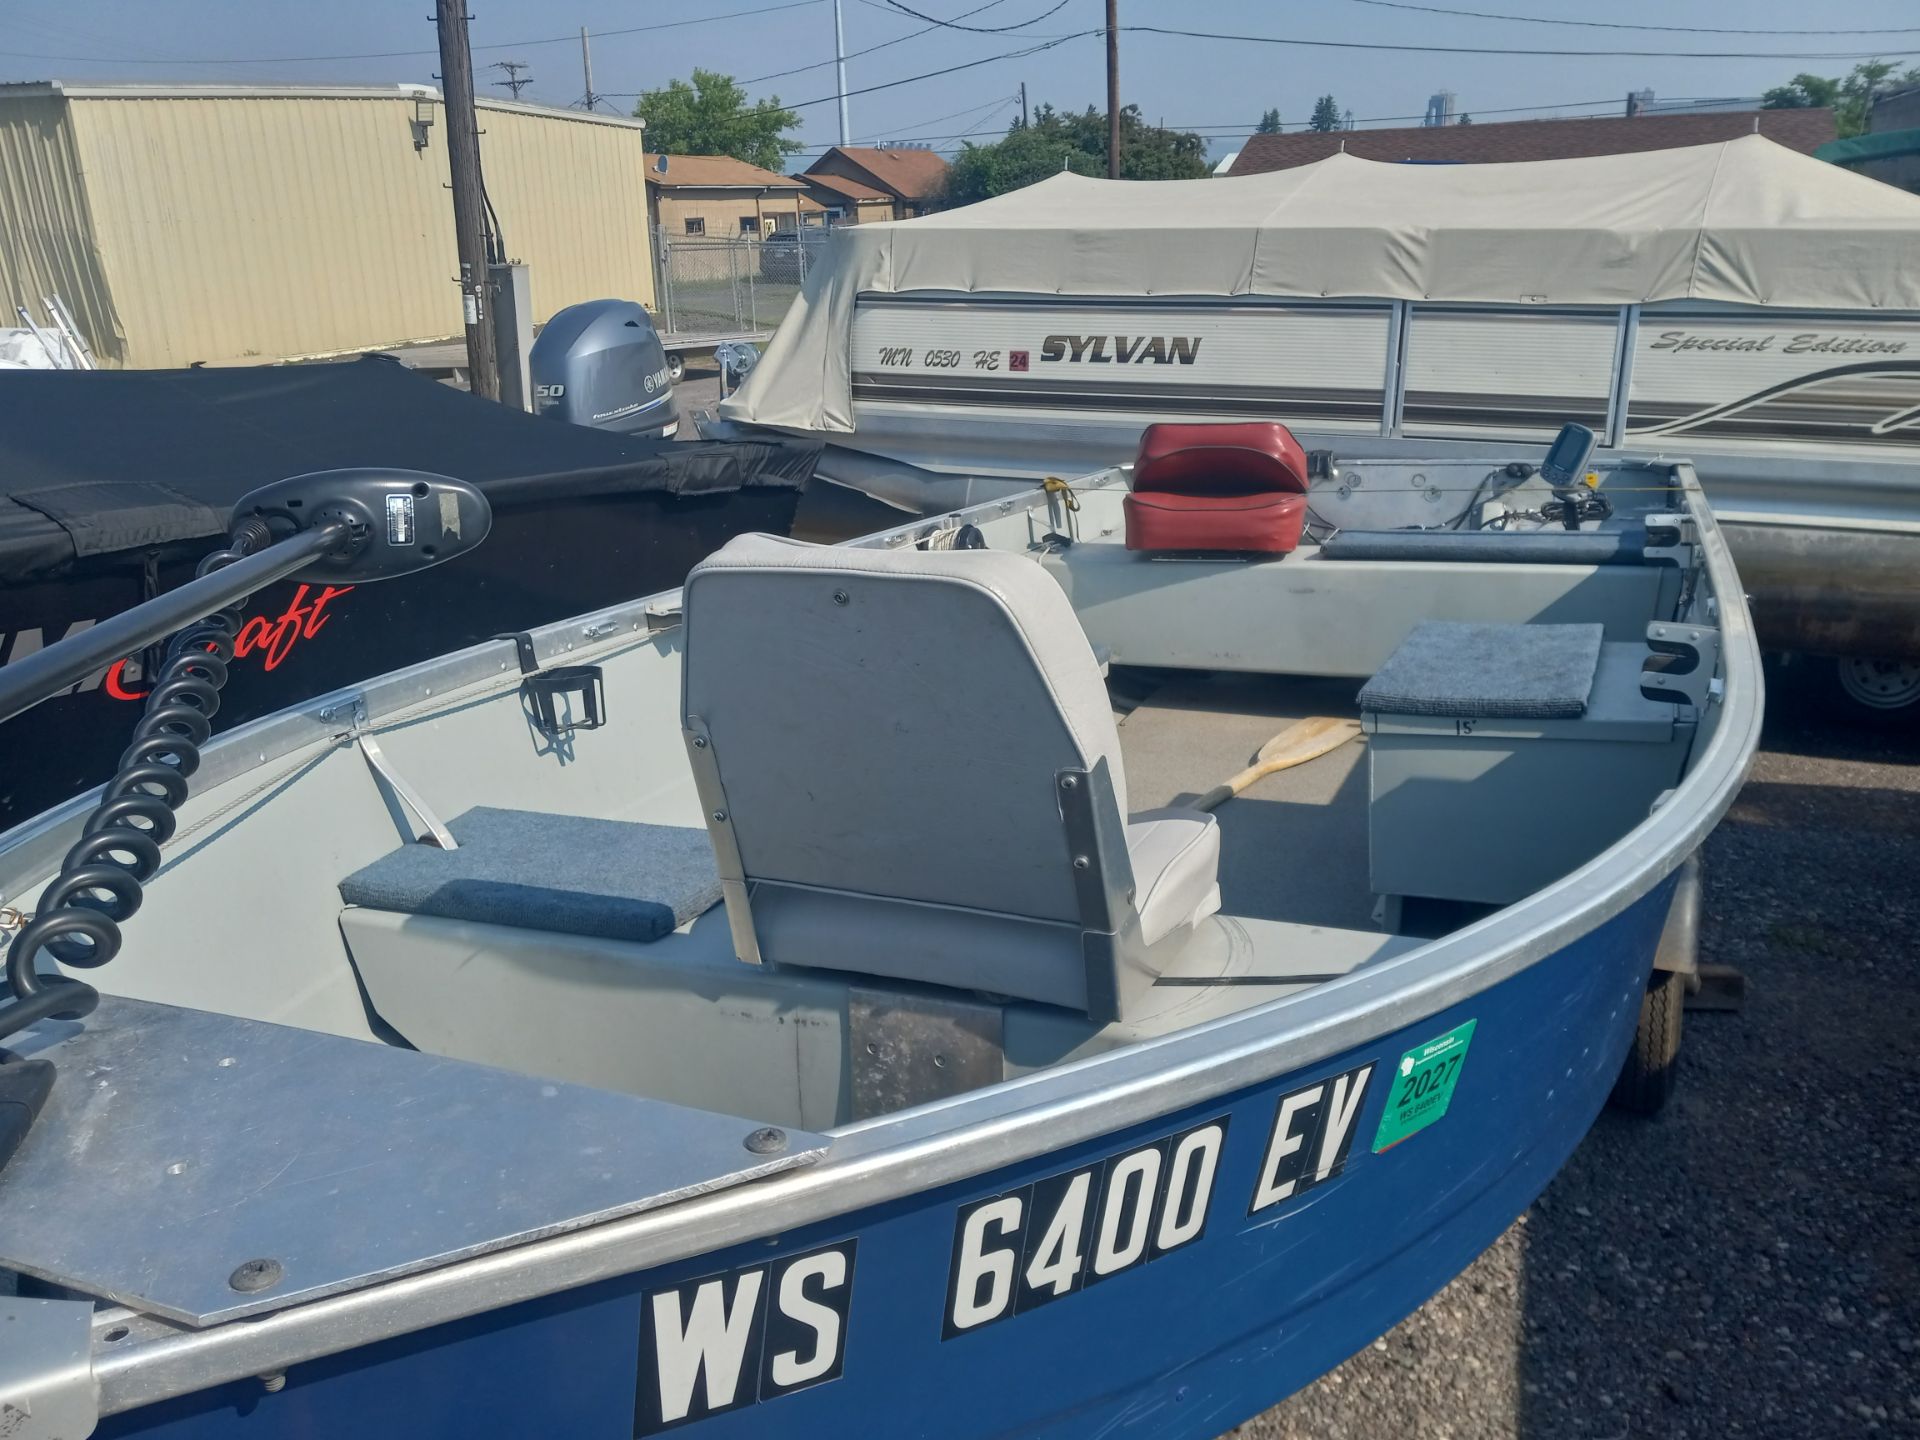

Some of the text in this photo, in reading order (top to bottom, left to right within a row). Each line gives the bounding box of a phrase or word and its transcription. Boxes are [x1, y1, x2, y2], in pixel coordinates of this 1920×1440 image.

[1040, 335, 1203, 365] SYLVAN
[1650, 331, 1909, 354] Special Edition
[879, 347, 1001, 370] MN 0530 HE
[1010, 353, 1027, 368] 24
[537, 384, 566, 398] 50
[1397, 1053, 1462, 1108] 2027
[652, 1068, 1373, 1423] WS 6400 EV
